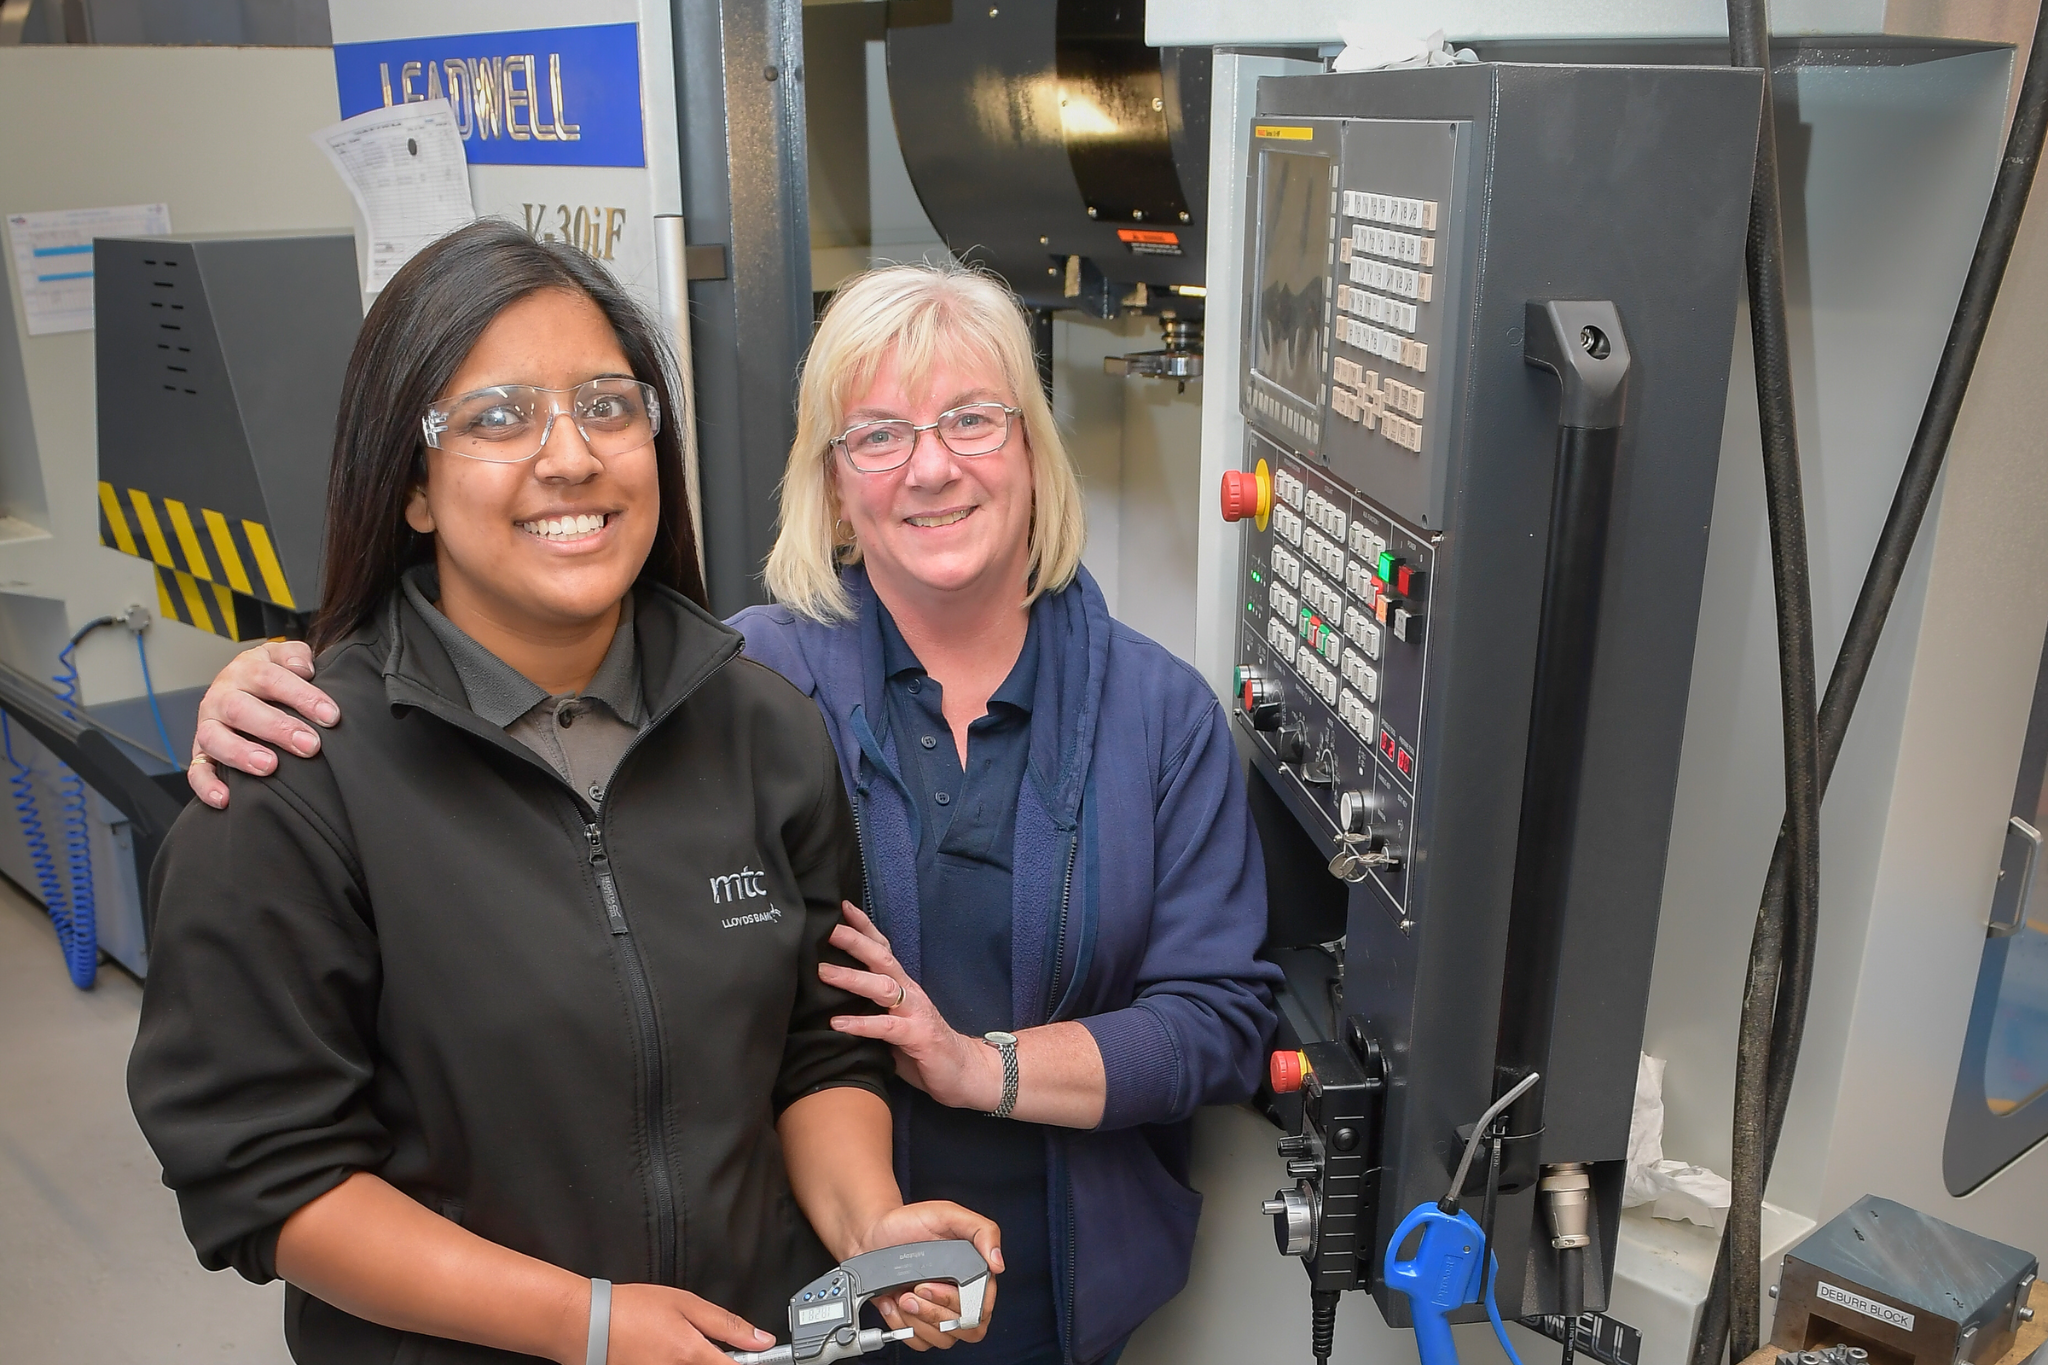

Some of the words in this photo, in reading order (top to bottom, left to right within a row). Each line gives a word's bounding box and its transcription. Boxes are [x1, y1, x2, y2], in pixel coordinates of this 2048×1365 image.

[709, 865, 767, 904] mtc
[721, 914, 753, 929] LLOYDS
[1821, 1286, 1867, 1310] DEBURR
[1870, 1304, 1909, 1326] BLOCK
